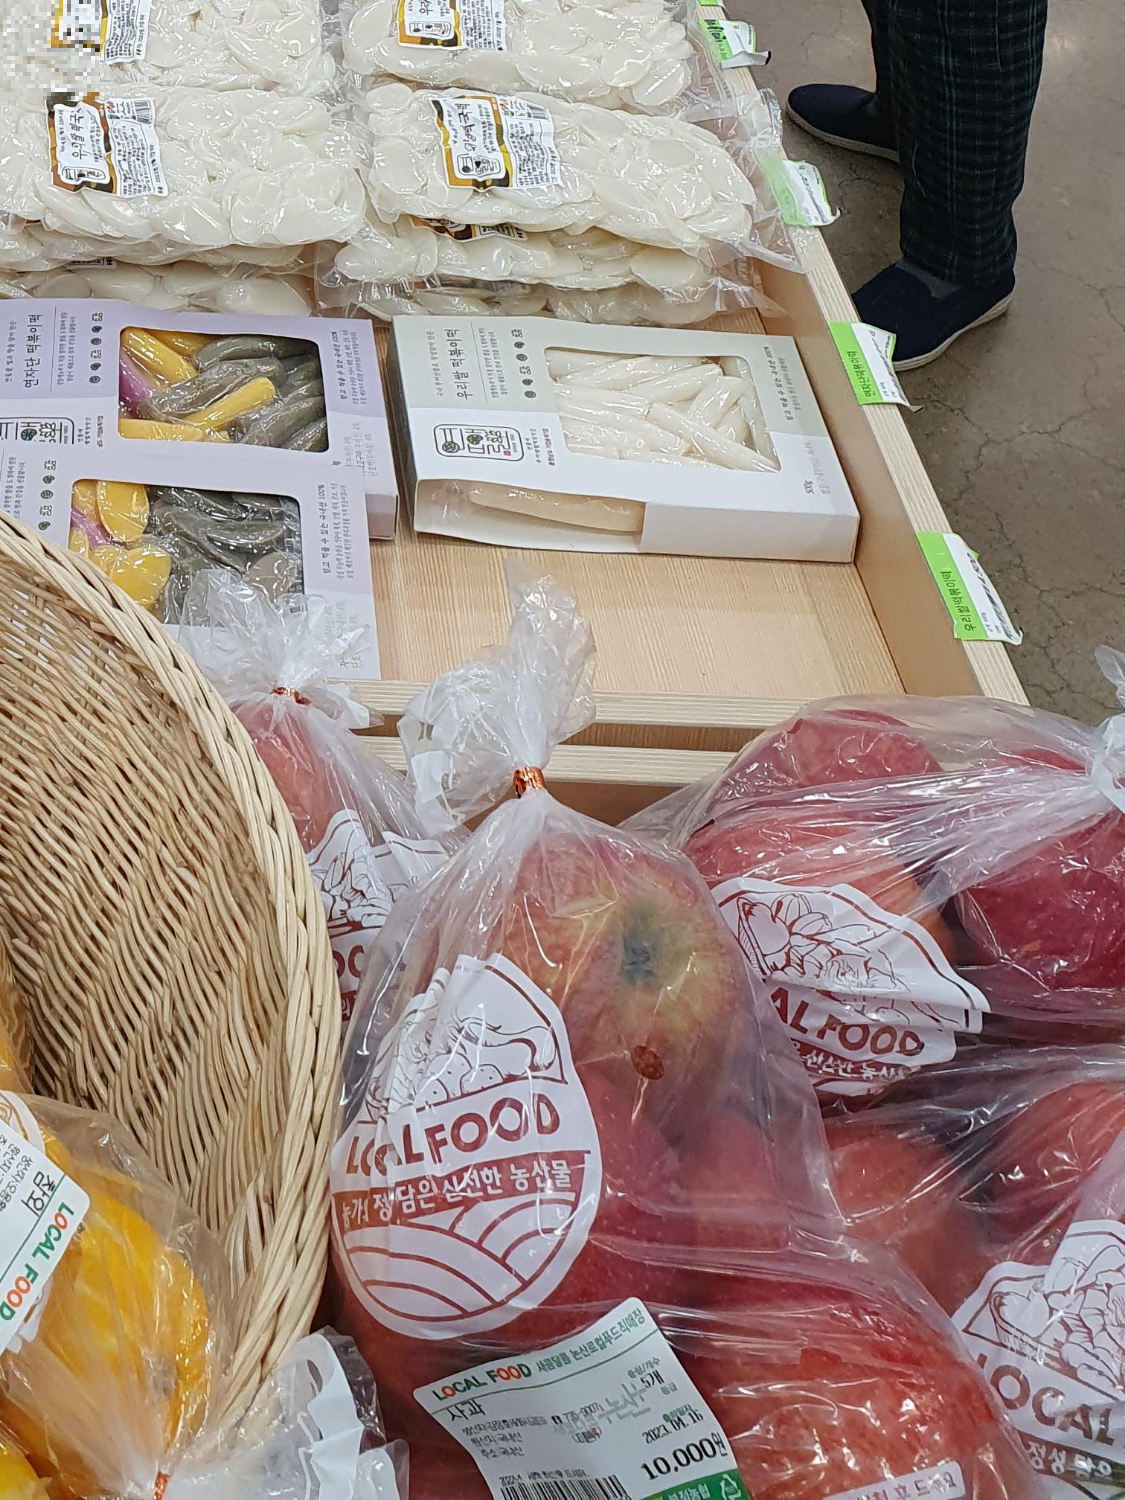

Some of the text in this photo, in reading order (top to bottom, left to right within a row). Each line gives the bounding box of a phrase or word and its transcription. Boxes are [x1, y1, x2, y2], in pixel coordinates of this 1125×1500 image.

[22, 313, 43, 388] 연자단 떡볶이떡
[445, 327, 472, 400] 우리쌀 떡볶이떡
[815, 1011, 926, 1065] FOOD
[421, 1089, 564, 1165] FOOD
[15, 1168, 61, 1218] 참외
[395, 1180, 437, 1214] 담은
[507, 1153, 573, 1197] 농산물
[25, 1201, 80, 1265] LOCAL
[431, 1371, 488, 1402] LOCAL
[485, 1358, 533, 1390] FOOD
[446, 1399, 485, 1420] 사과
[641, 1423, 673, 1444] 2023.
[636, 1430, 729, 1481] 10,000원
